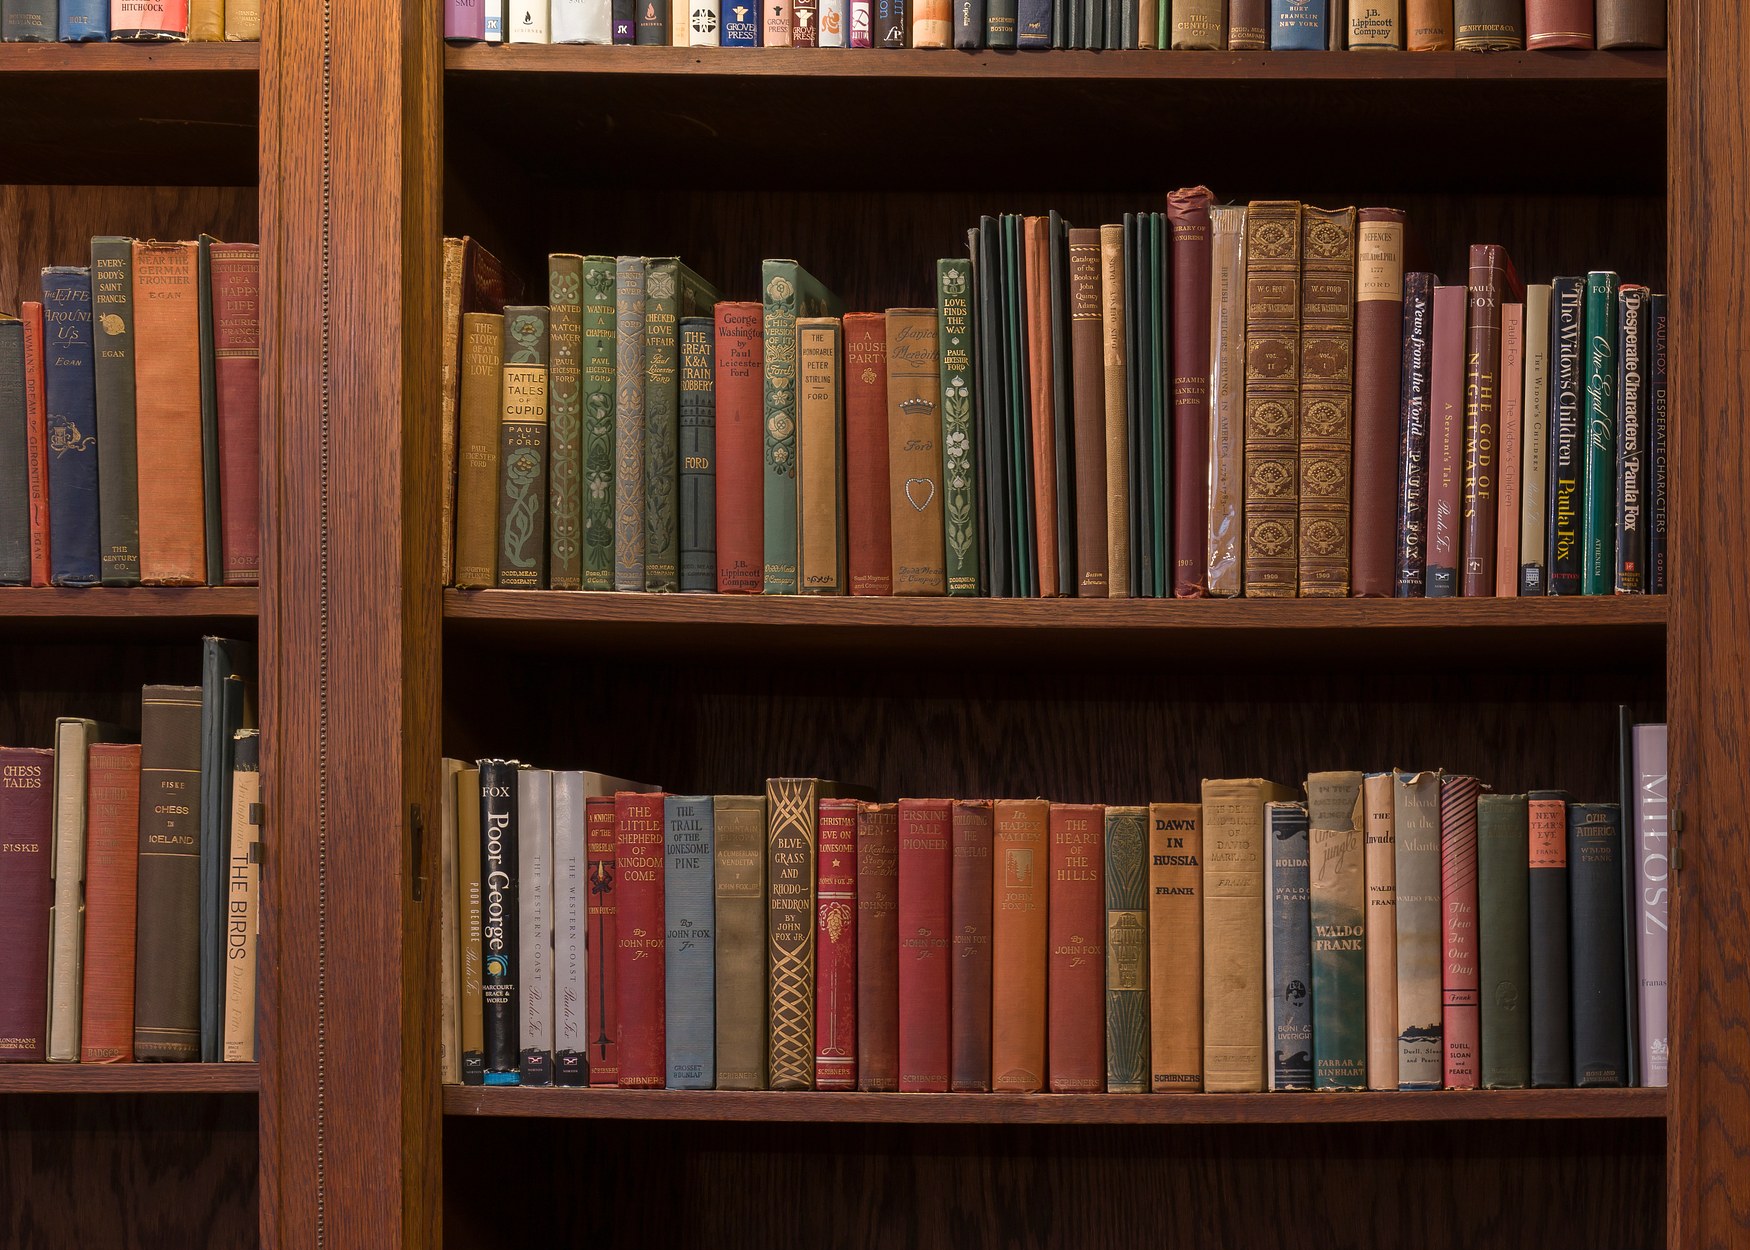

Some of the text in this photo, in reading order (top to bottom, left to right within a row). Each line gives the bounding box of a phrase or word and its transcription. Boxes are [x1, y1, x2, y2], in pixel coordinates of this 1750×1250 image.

[121, 3, 164, 12] HITCHCOCK
[1365, 9, 1380, 18] J.B.
[726, 23, 755, 31] GROVE
[1352, 18, 1392, 28] Lippincott
[728, 31, 754, 39] PRESS
[1354, 28, 1391, 36] Company
[1560, 288, 1579, 322] The
[723, 314, 757, 326] George
[737, 339, 747, 349] by
[730, 348, 751, 358] Paul
[719, 359, 762, 368] Leicester
[730, 368, 750, 377] Ford
[508, 373, 545, 383] TATTLE
[509, 386, 543, 395] TALES
[506, 405, 544, 415] CUPID
[1559, 391, 1577, 466] Children
[1558, 477, 1576, 527] Paula
[1558, 530, 1575, 560] Fox
[4, 766, 41, 776] CHESS
[4, 778, 41, 788] TALES
[483, 786, 510, 798] FOX
[1156, 820, 1196, 830] DAWN
[3, 844, 39, 852] FISKE
[1168, 838, 1184, 848] IN
[1154, 855, 1198, 866] RUSSIA
[484, 811, 510, 950] Poor George
[1156, 886, 1194, 896] FRANK
[230, 853, 248, 959] THE BIRDS
[1316, 926, 1364, 937] WALDO
[1316, 939, 1362, 951] FRANK
